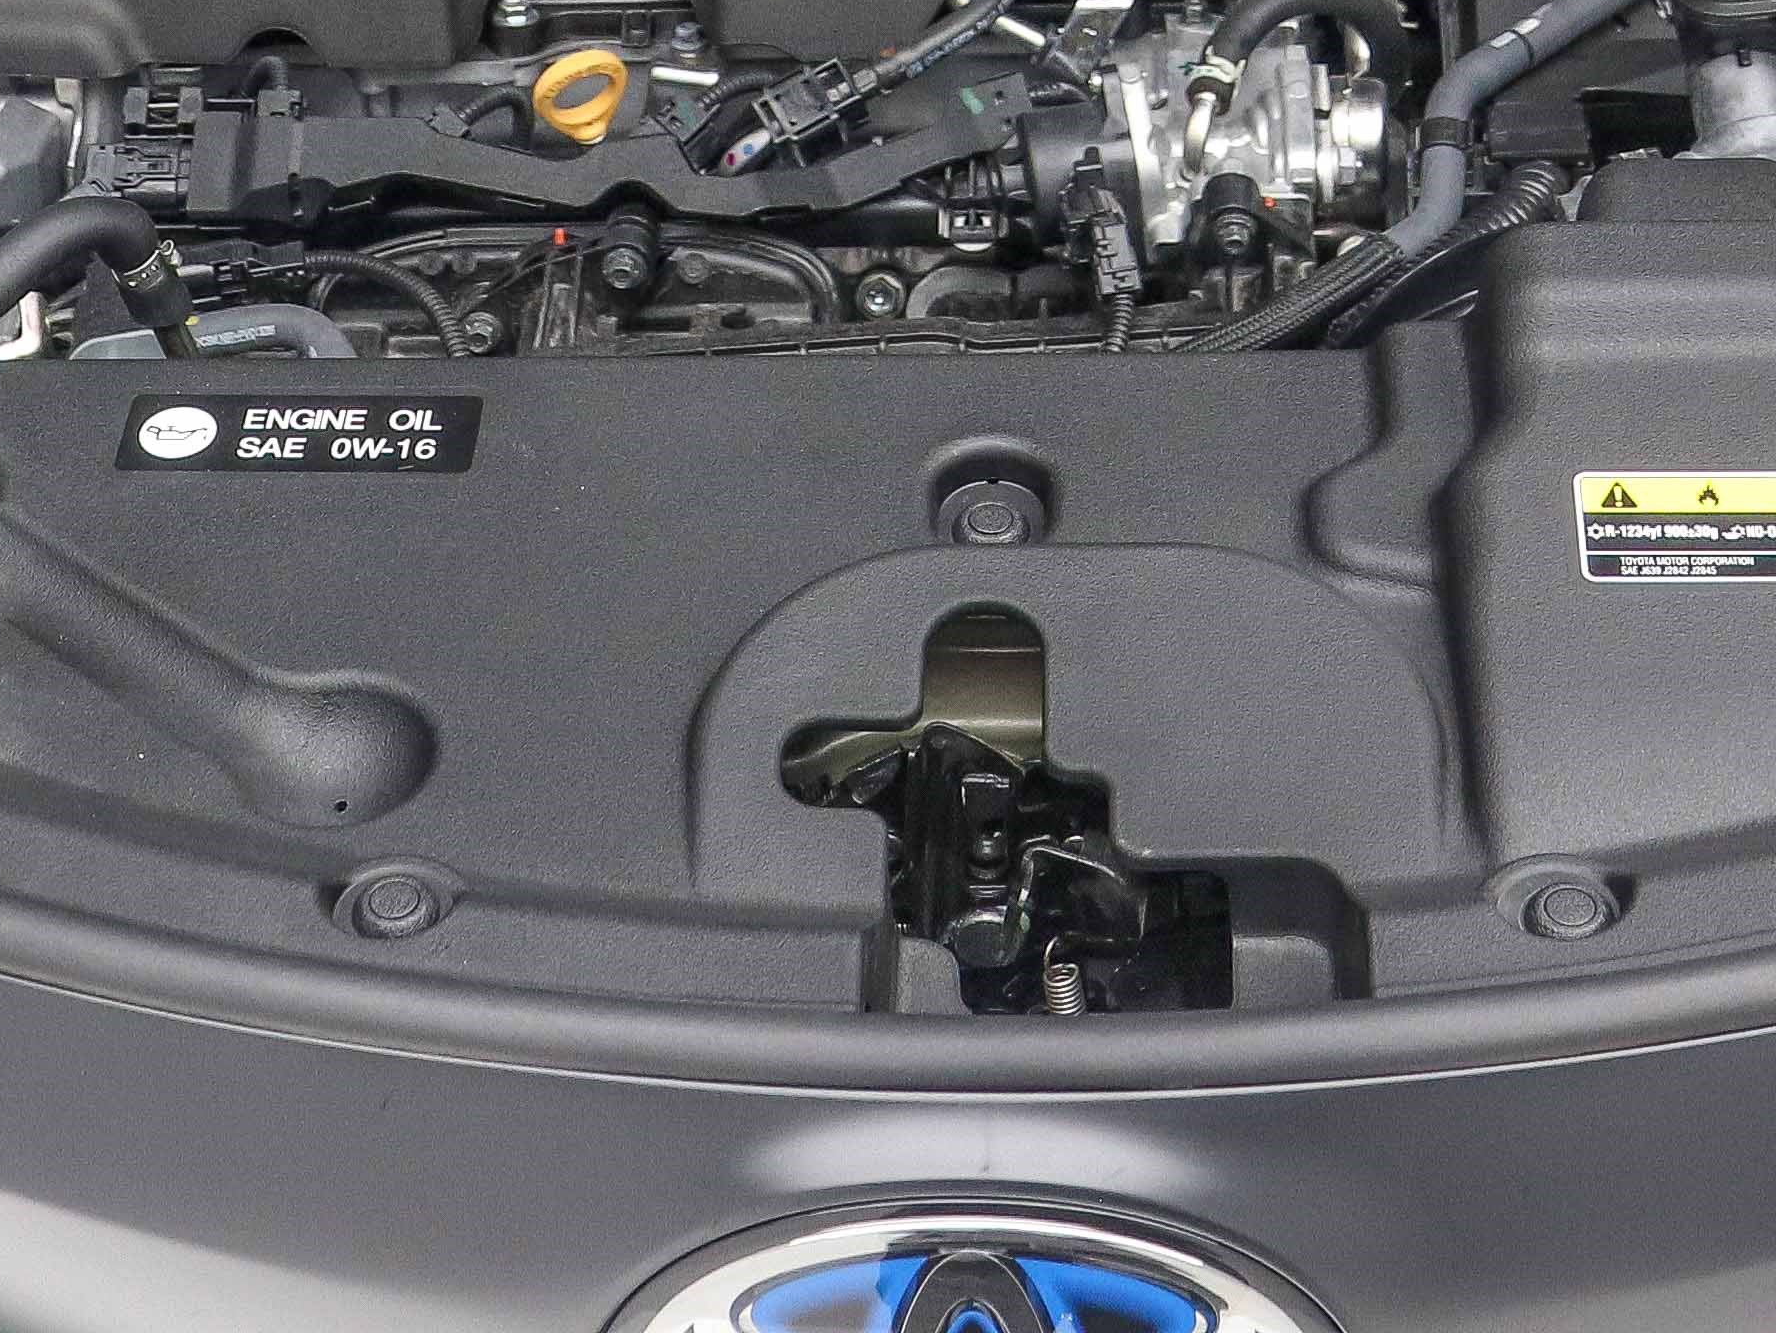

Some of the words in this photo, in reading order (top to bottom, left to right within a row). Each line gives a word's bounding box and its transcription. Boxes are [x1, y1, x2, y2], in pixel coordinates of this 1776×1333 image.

[242, 408, 368, 432] ENGINE
[388, 409, 443, 432] OIL
[235, 436, 306, 460] SAE
[330, 437, 437, 460] 0W-16
[1620, 556, 1655, 566] TOYOTA
[1656, 556, 1690, 566] MOTOR
[1690, 556, 1755, 566] CORPORATION
